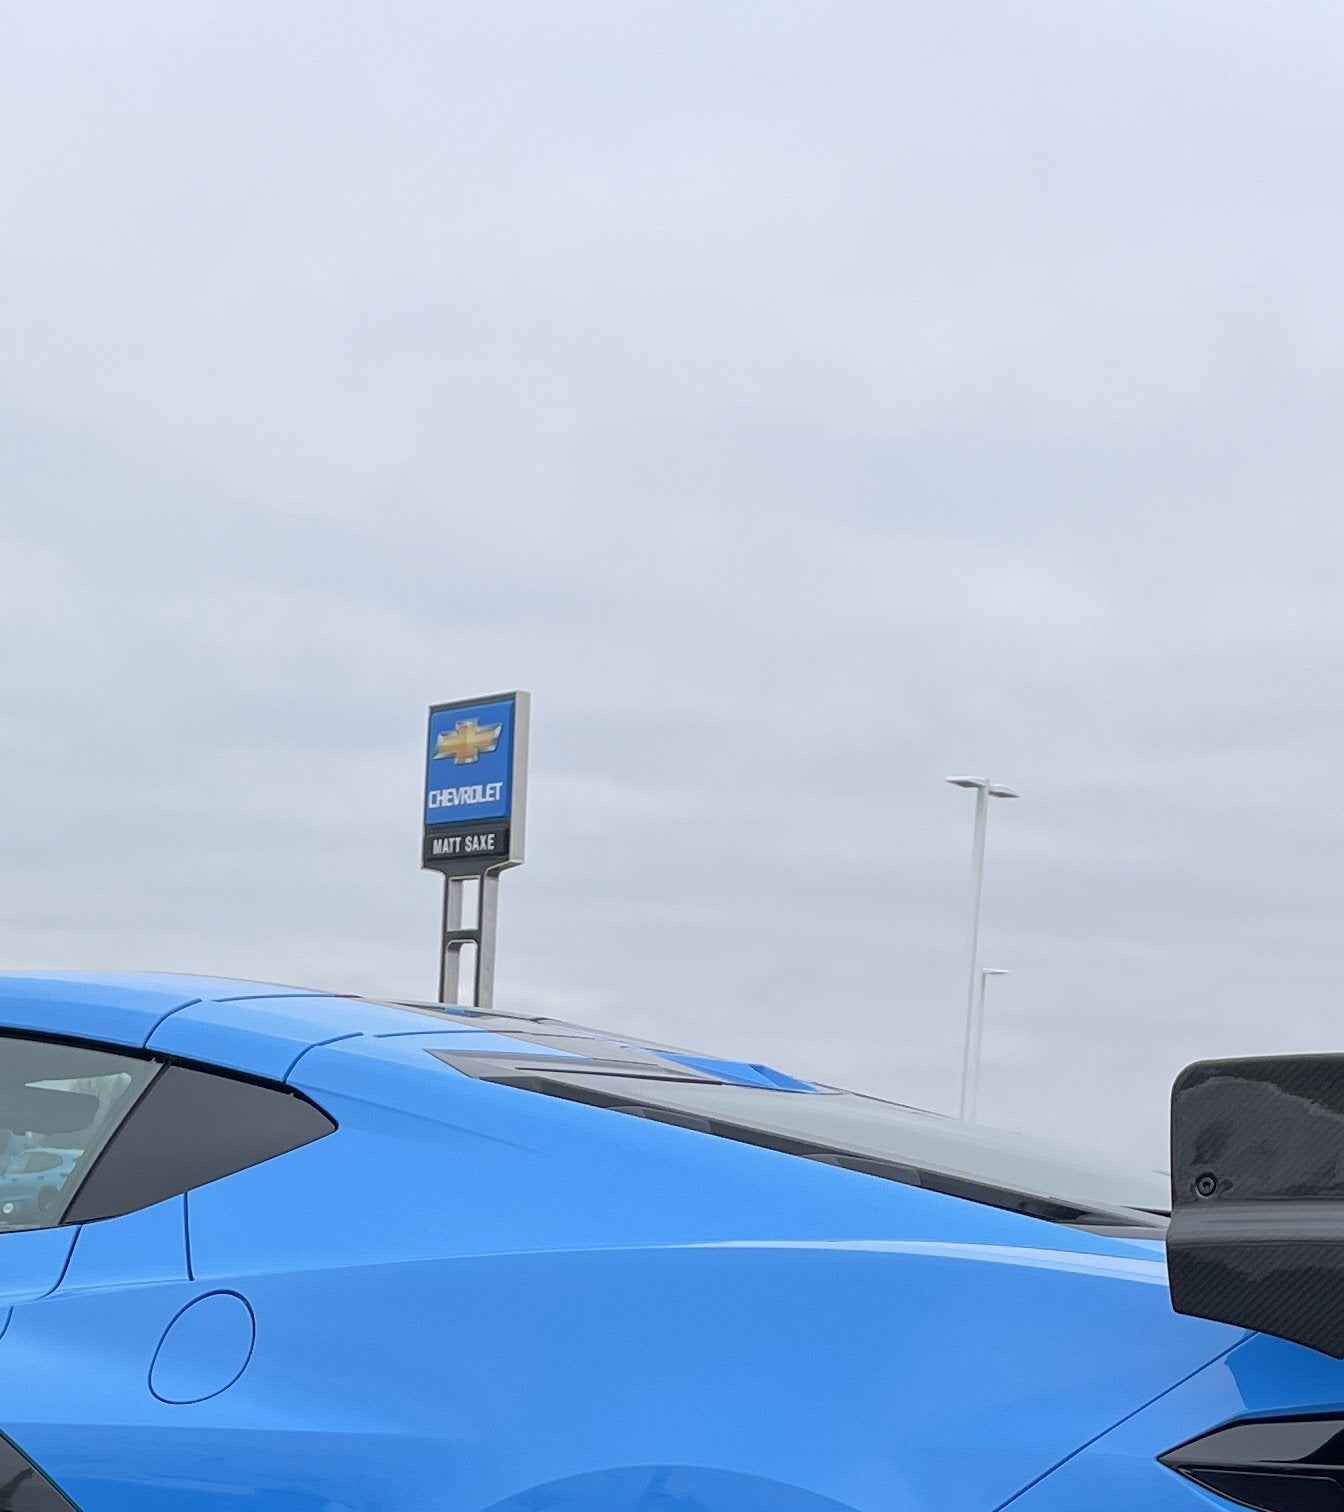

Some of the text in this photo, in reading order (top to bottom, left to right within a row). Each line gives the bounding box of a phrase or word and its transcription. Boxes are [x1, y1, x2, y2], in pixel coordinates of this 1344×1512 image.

[428, 782, 504, 809] CHEVROLET
[433, 833, 495, 855] MATT SAXE
